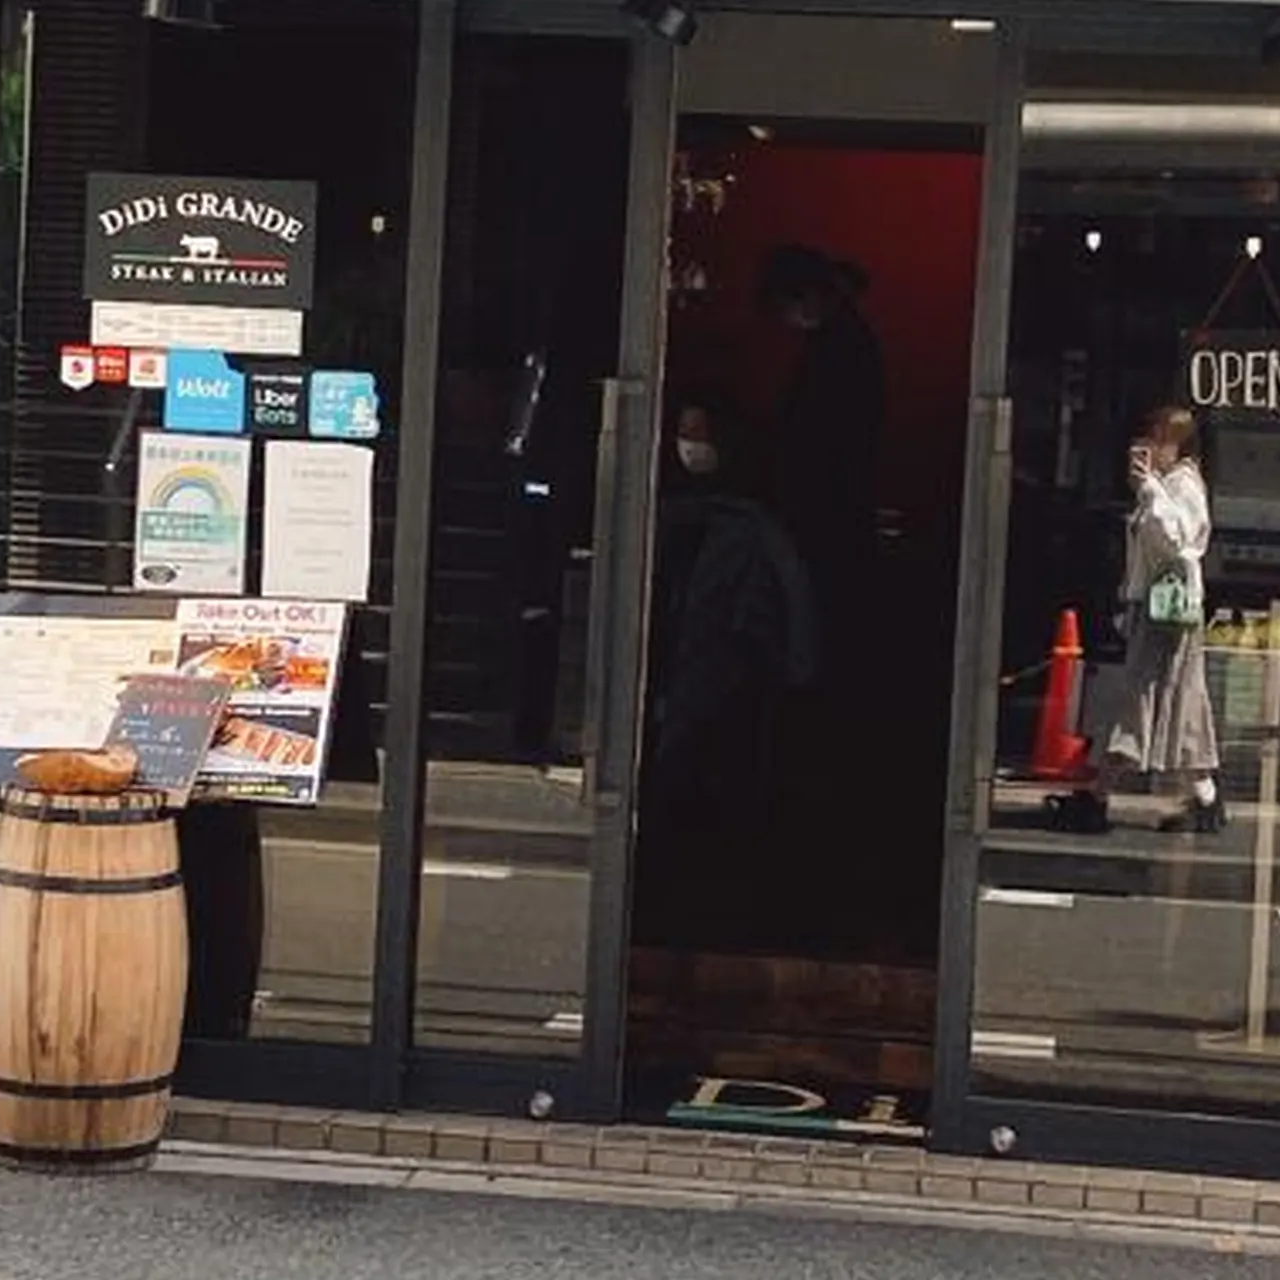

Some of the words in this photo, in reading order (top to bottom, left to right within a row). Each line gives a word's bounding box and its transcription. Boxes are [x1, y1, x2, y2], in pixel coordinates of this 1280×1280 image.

[99, 195, 169, 236] DiDi
[176, 192, 304, 244] GRANDE
[111, 263, 174, 282] STEAK
[182, 267, 195, 283] &
[203, 267, 288, 287] ITALIAN
[253, 387, 299, 406] Uber
[253, 406, 298, 425] Eats
[242, 603, 280, 620] Out
